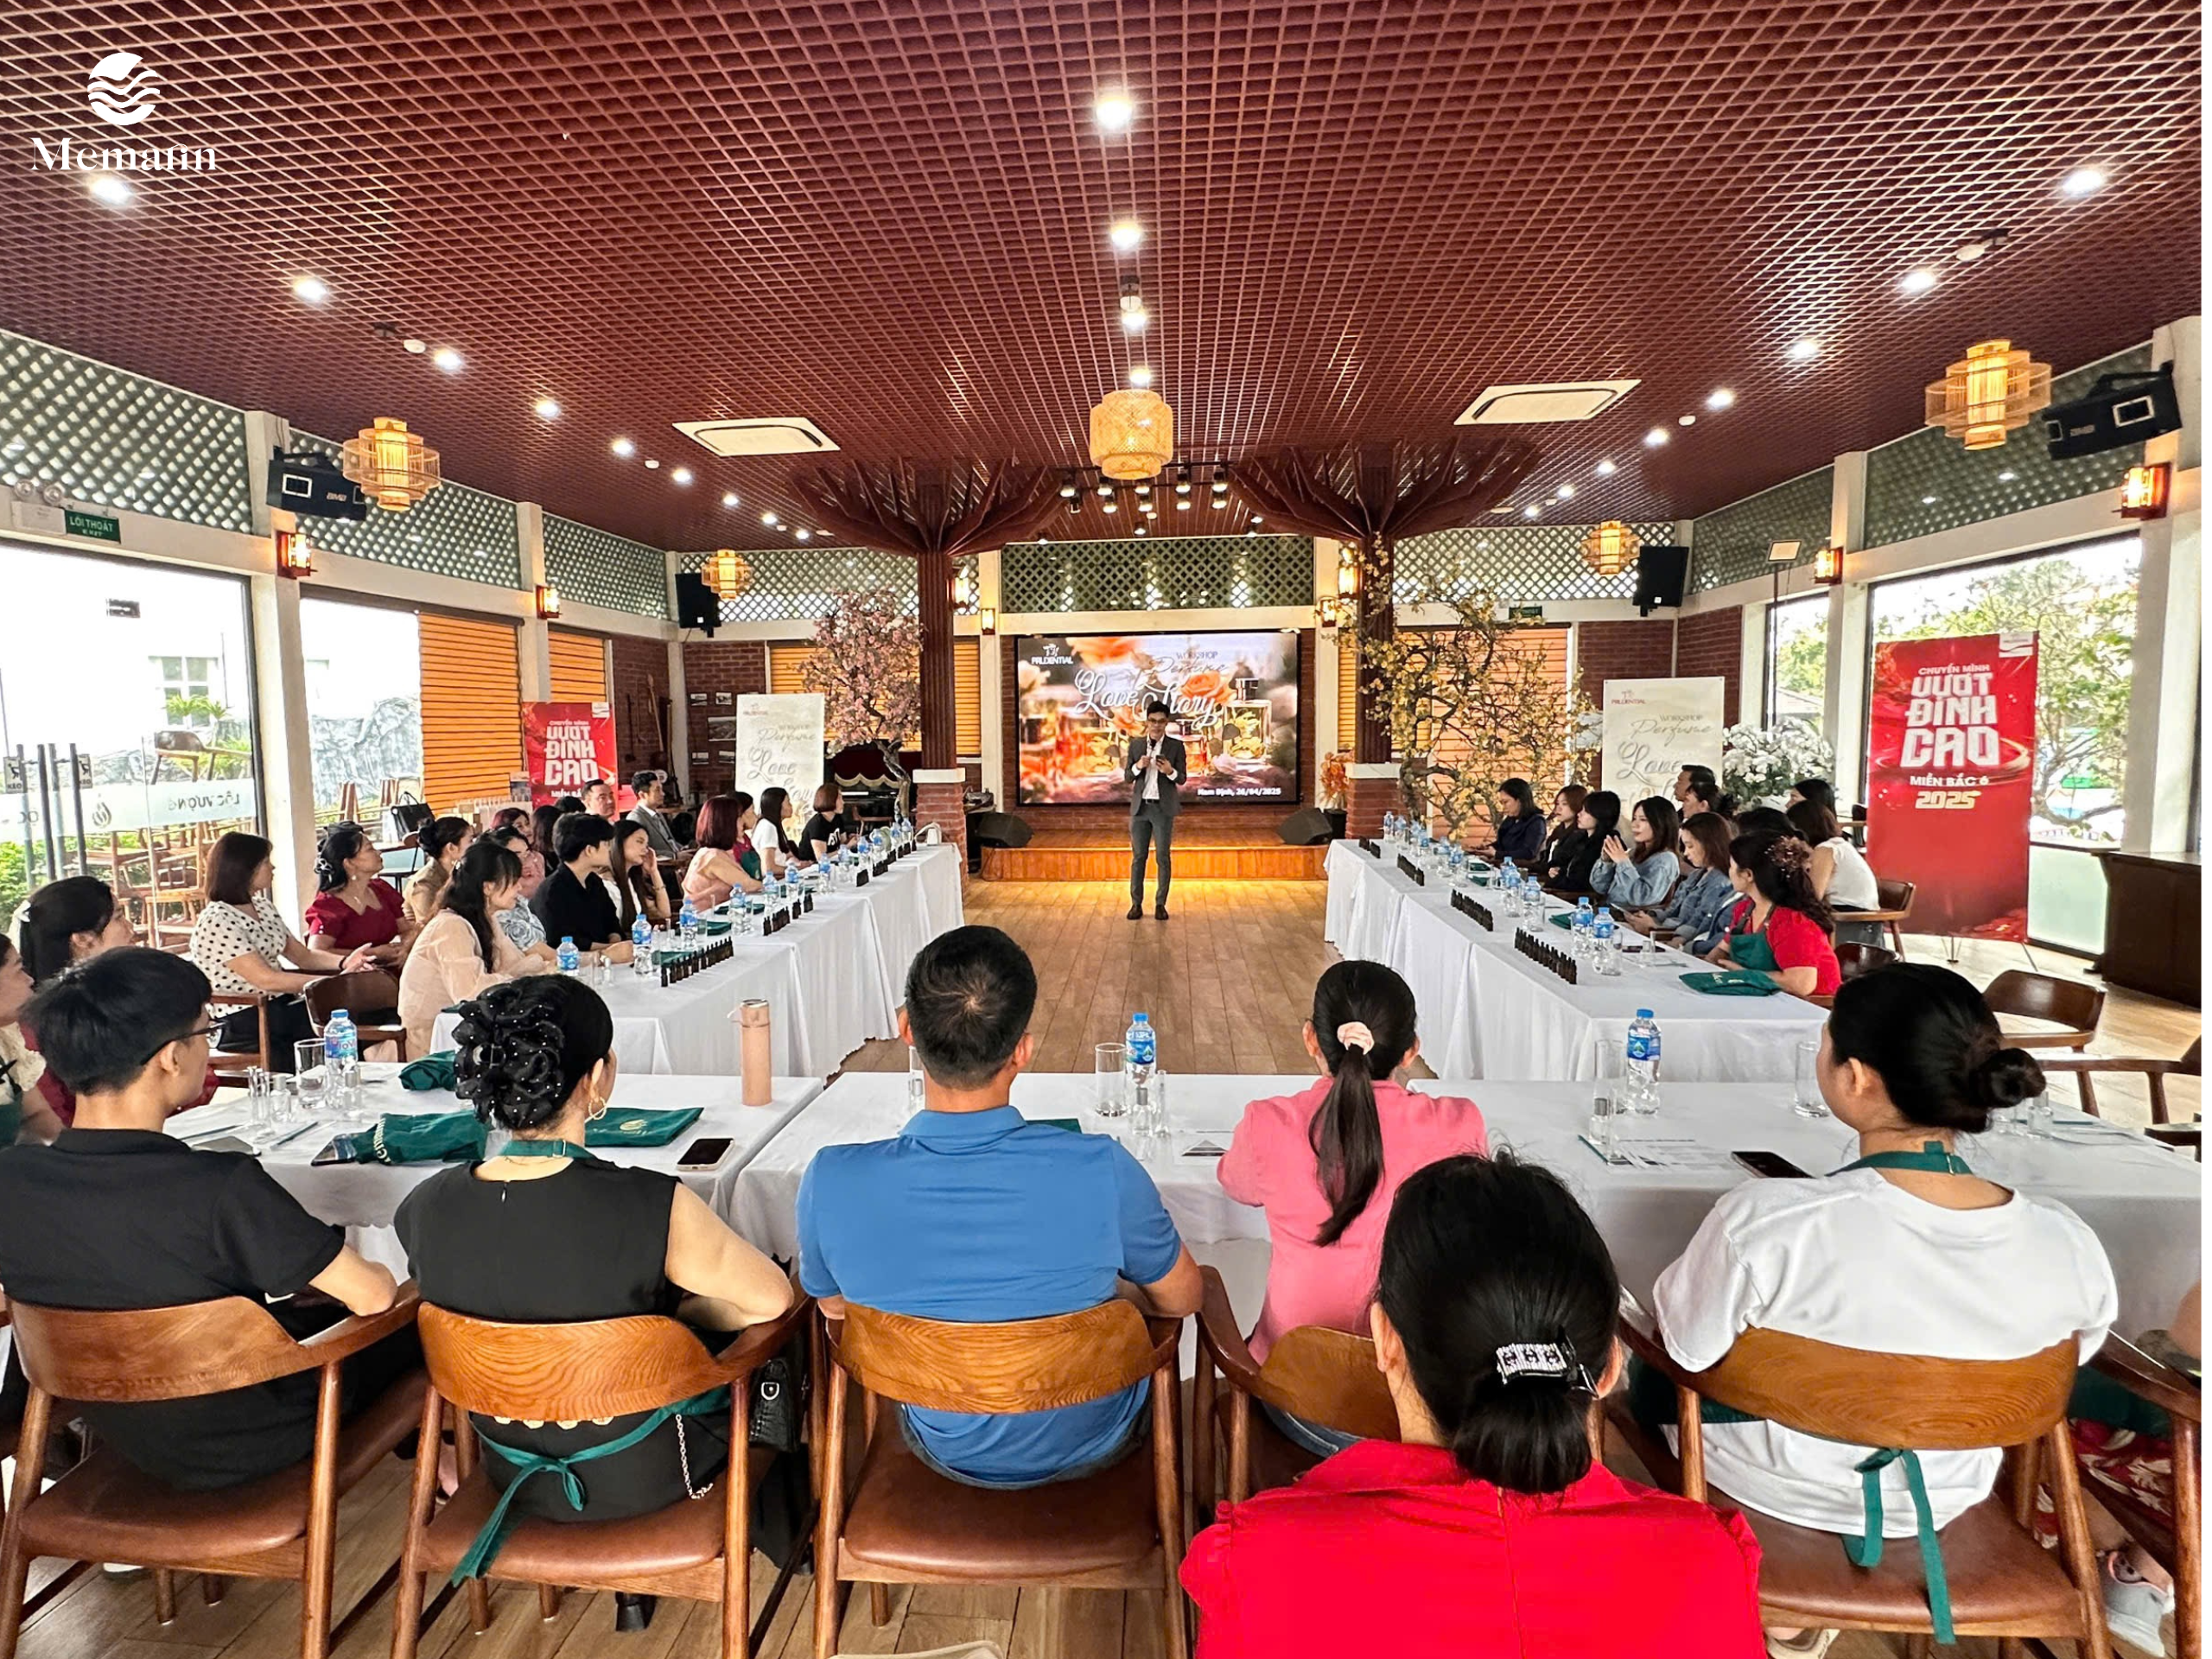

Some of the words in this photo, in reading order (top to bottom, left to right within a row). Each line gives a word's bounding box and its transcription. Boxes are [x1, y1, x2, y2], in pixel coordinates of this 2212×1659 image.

[1031, 656, 1074, 665] PRUDENTIAL
[1075, 669, 1140, 721] Love
[1899, 726, 2000, 768] CAO
[544, 759, 600, 785] CAO
[1979, 775, 1989, 786] 6
[1915, 790, 1982, 810] 2025
